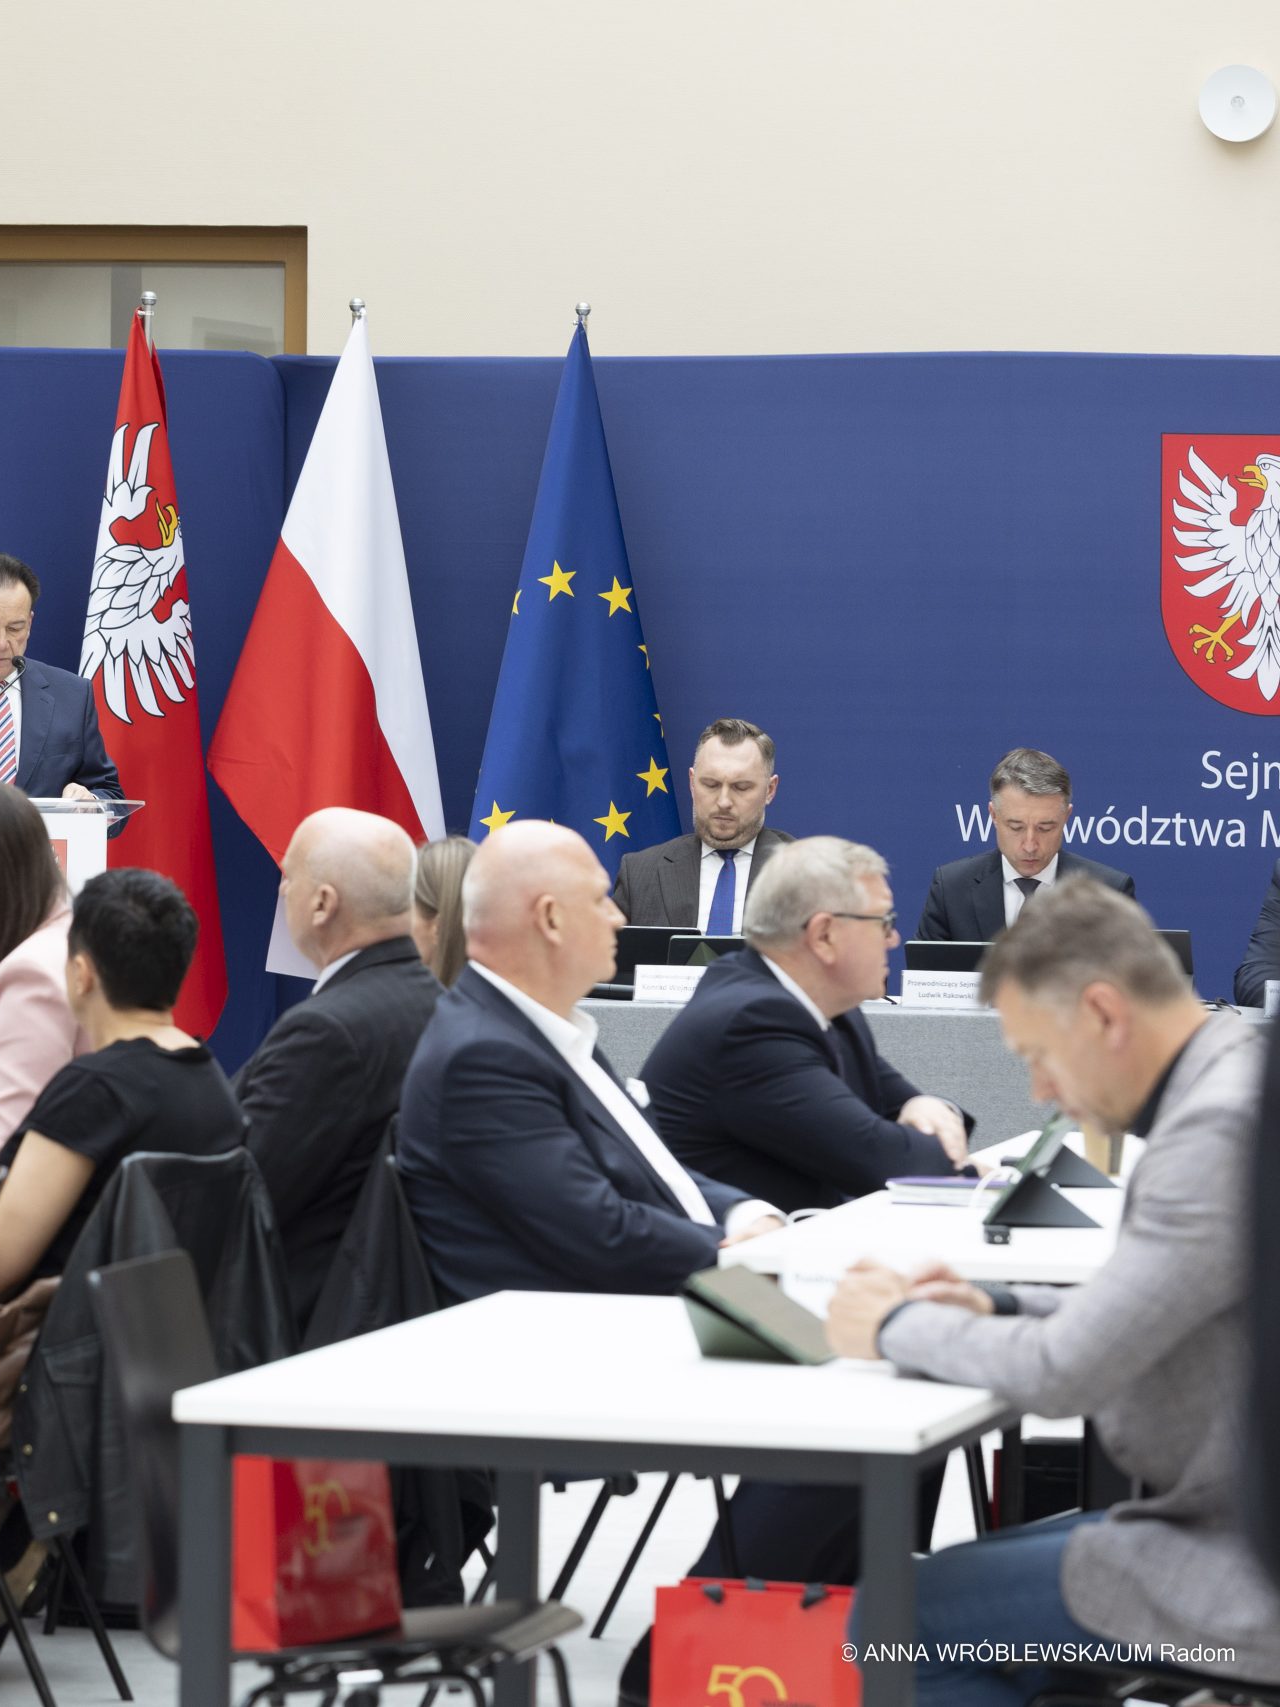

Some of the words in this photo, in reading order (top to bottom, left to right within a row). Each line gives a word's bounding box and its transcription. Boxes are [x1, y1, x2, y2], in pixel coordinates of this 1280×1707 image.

[955, 804, 1246, 848] Wwództwa
[1260, 809, 1280, 848] M
[918, 991, 941, 999] Ludwik
